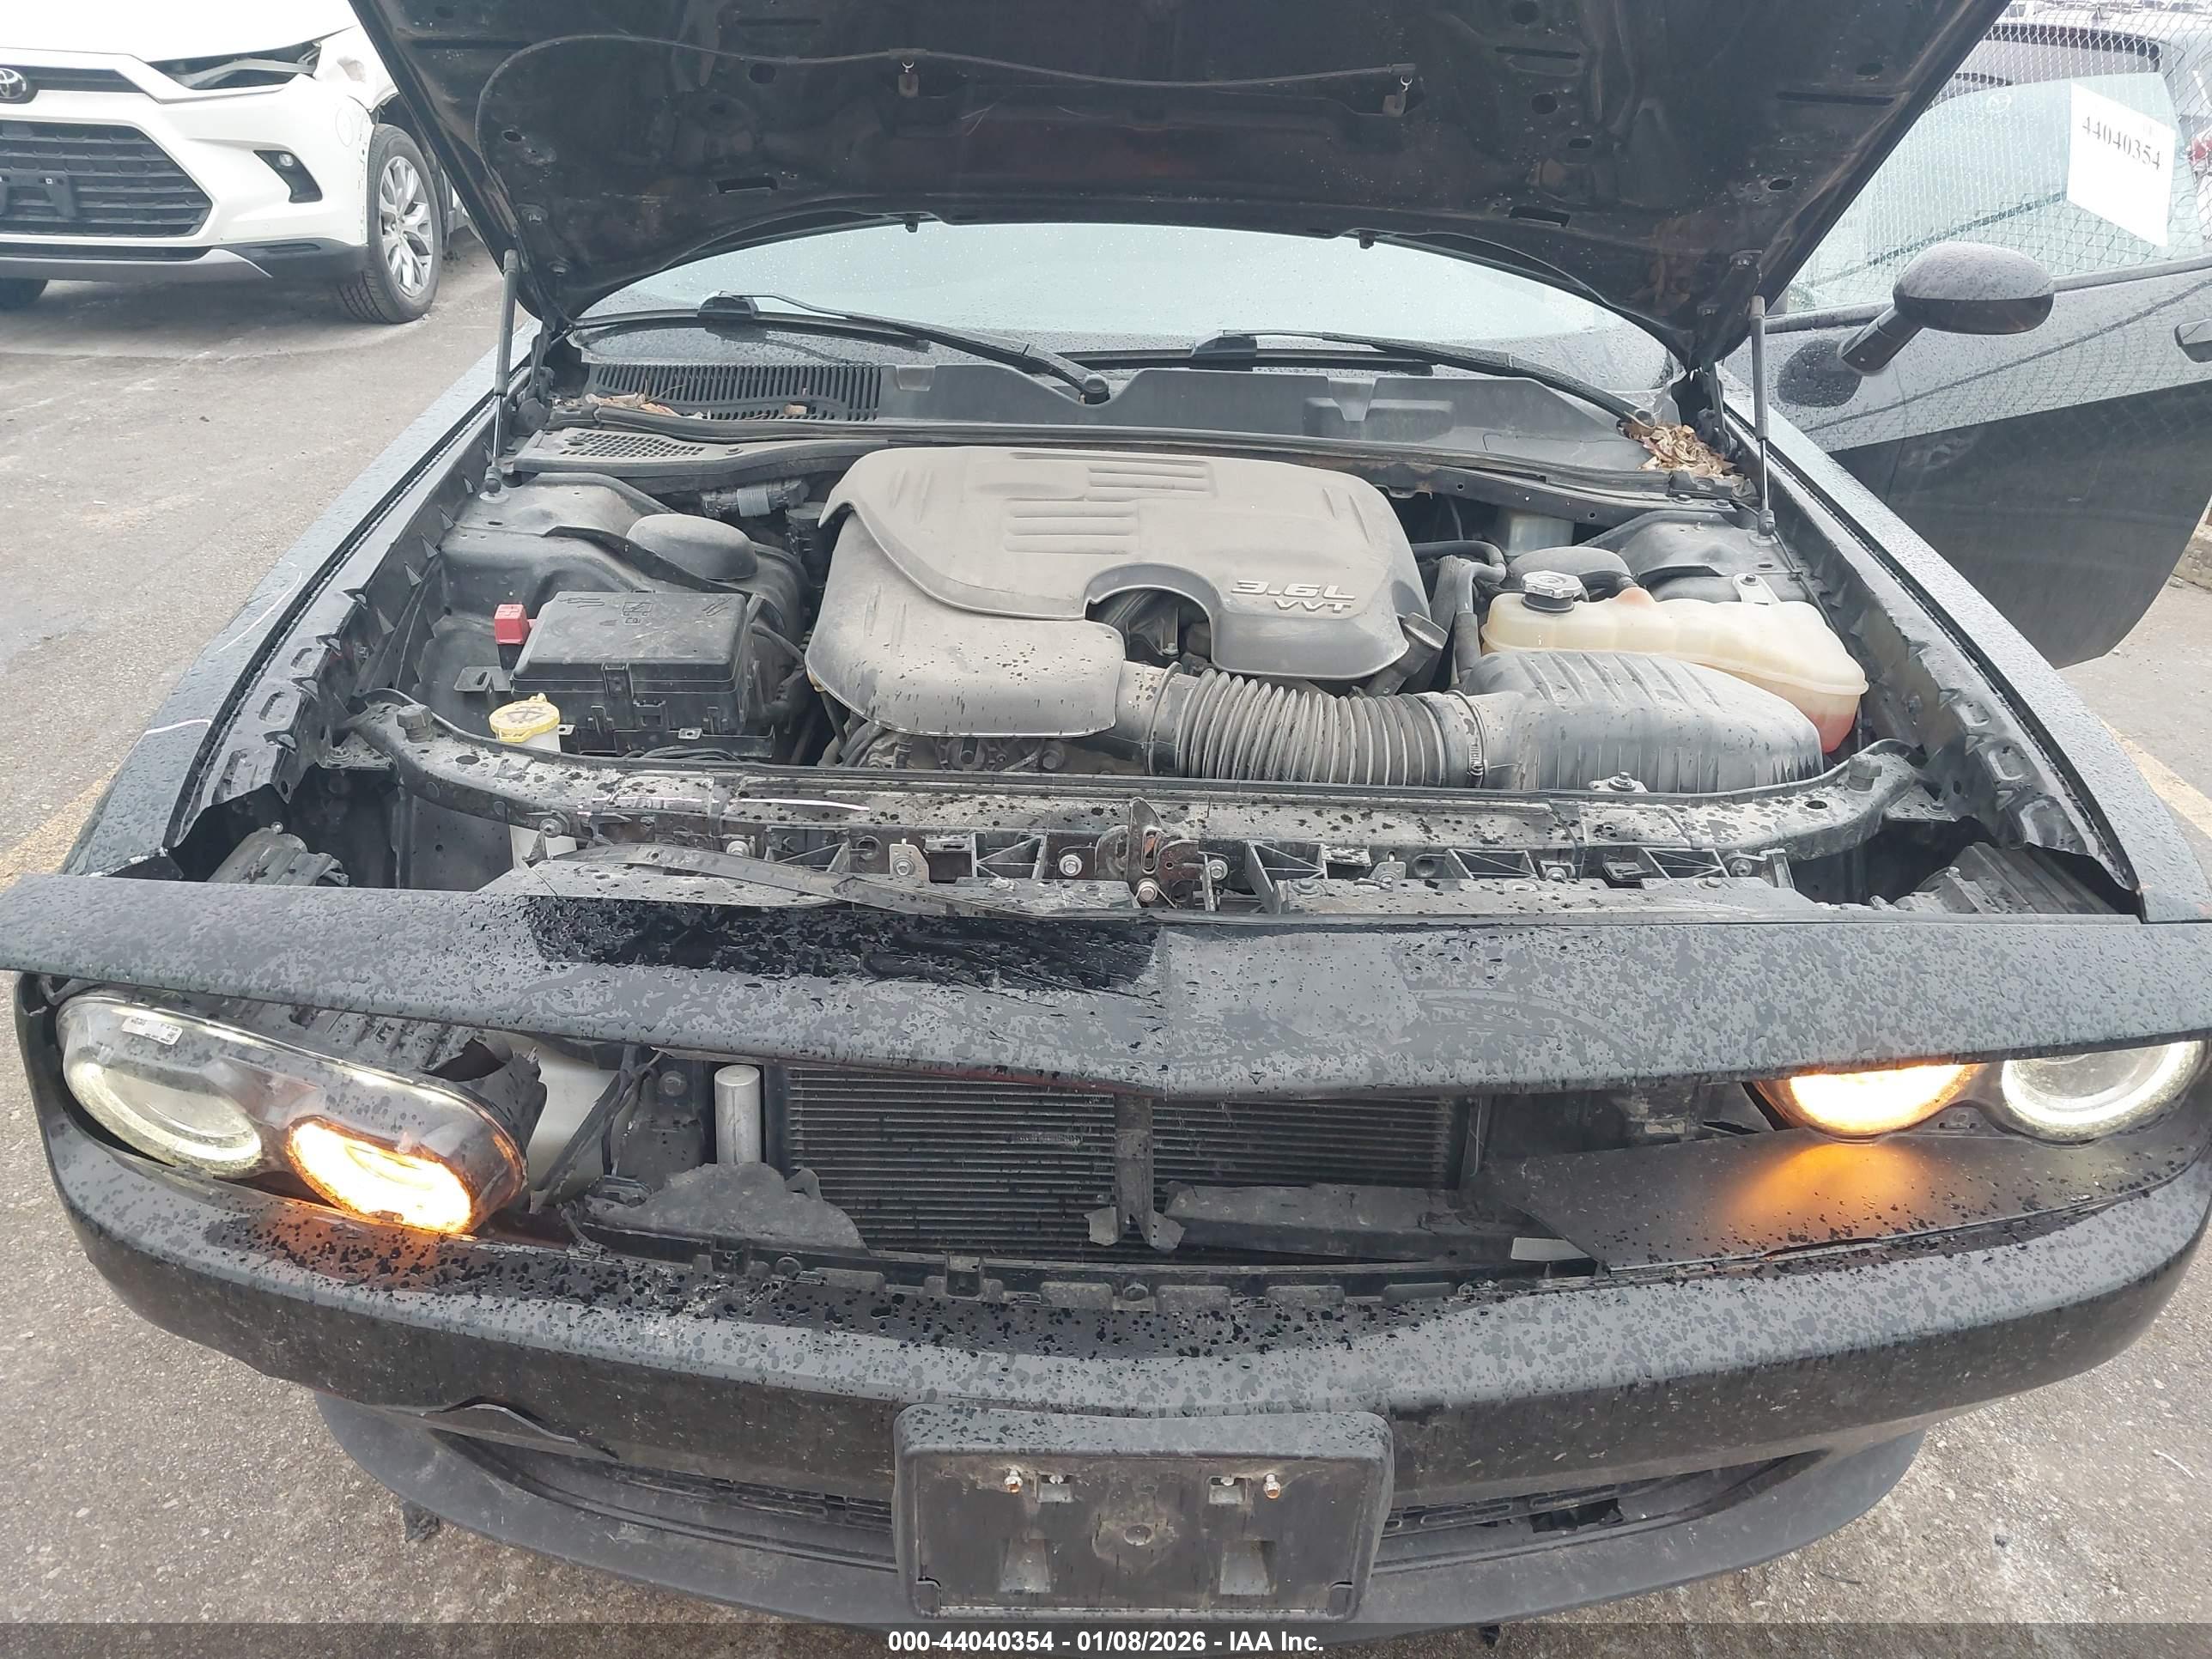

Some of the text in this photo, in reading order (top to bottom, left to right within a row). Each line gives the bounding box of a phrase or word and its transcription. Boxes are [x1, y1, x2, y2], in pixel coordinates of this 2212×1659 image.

[2081, 116, 2160, 171] 44040354
[1231, 580, 1355, 600] 3.6L
[1274, 599, 1351, 613] VVT
